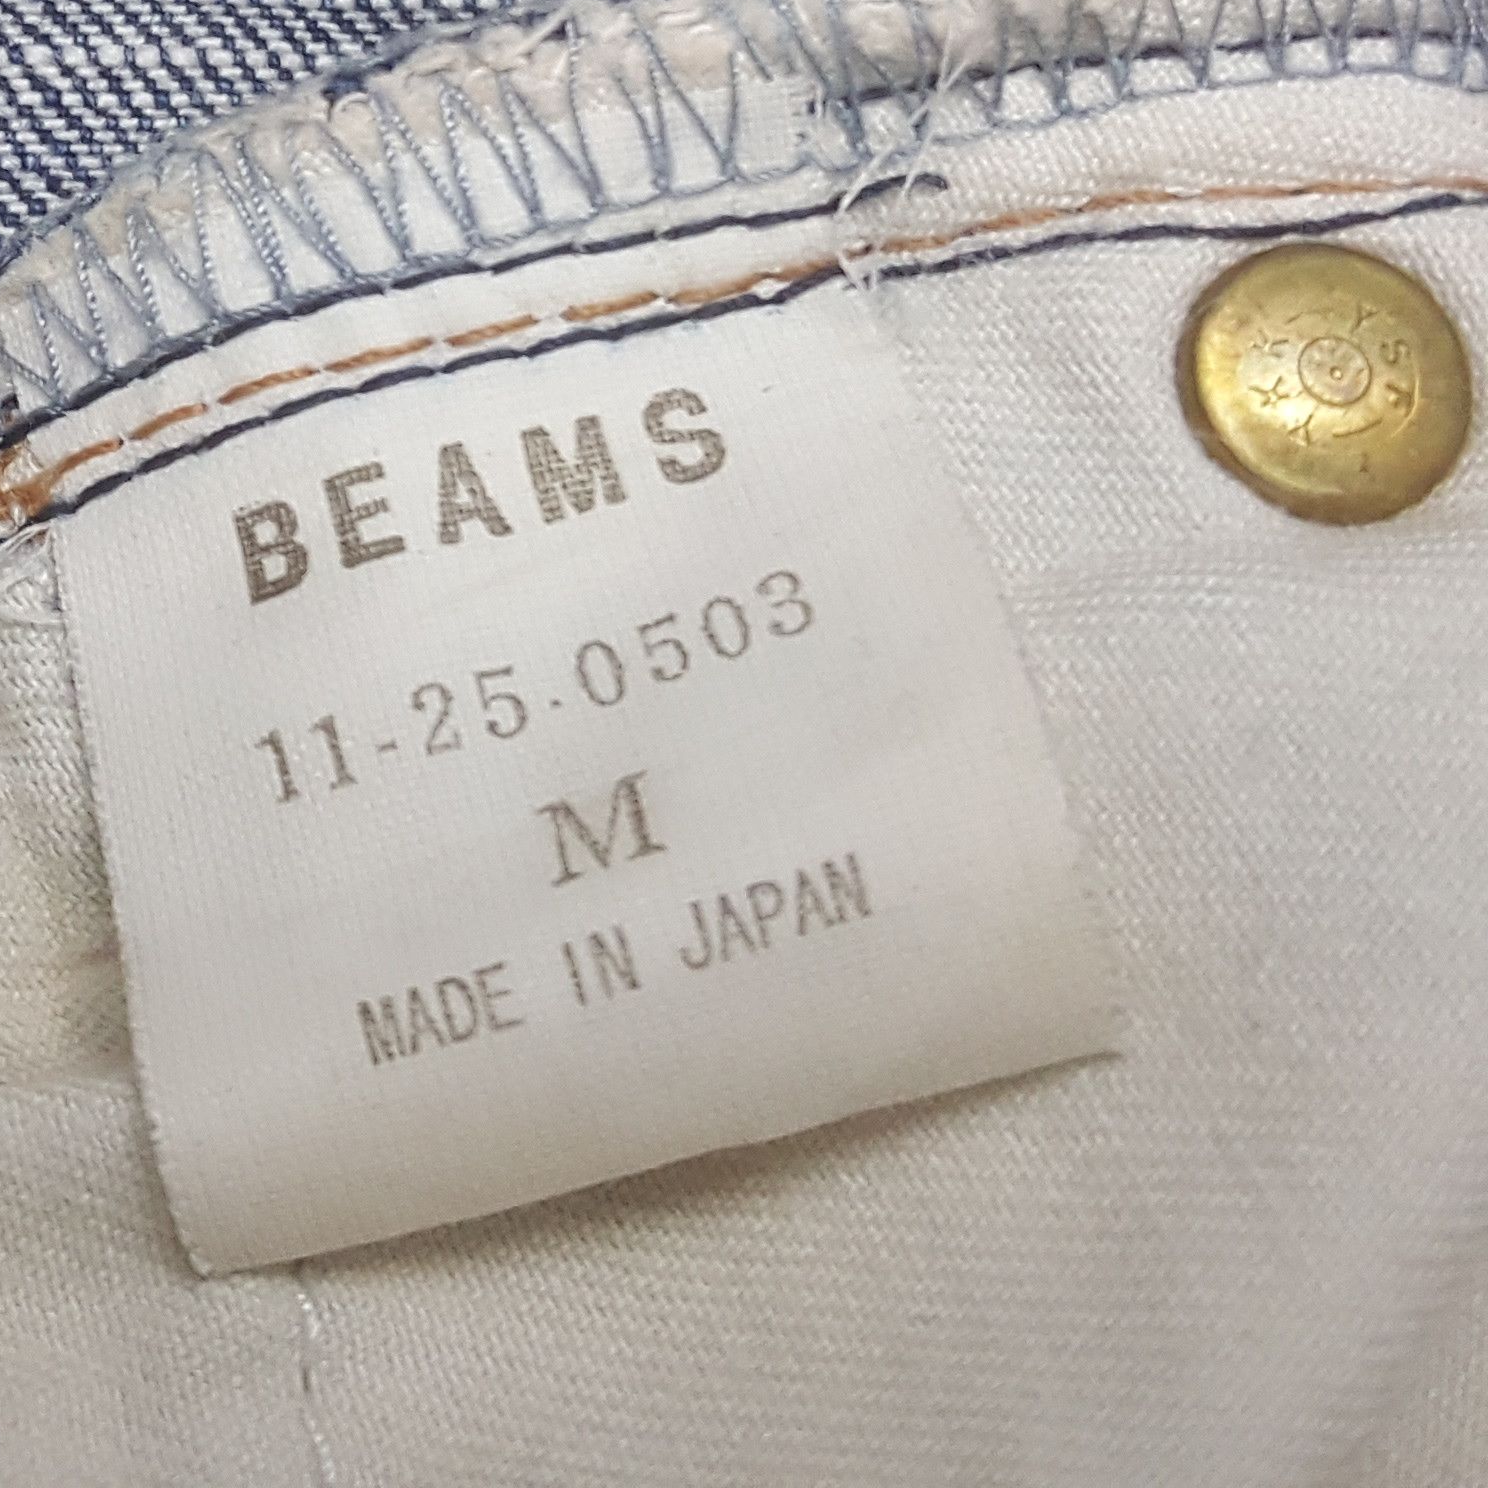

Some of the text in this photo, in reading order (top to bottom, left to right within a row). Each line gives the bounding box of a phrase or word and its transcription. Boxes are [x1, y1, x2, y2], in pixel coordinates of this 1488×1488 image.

[231, 388, 727, 604] BEAMS
[537, 771, 667, 887] M
[358, 855, 872, 1066] MADE IN JAPAN
